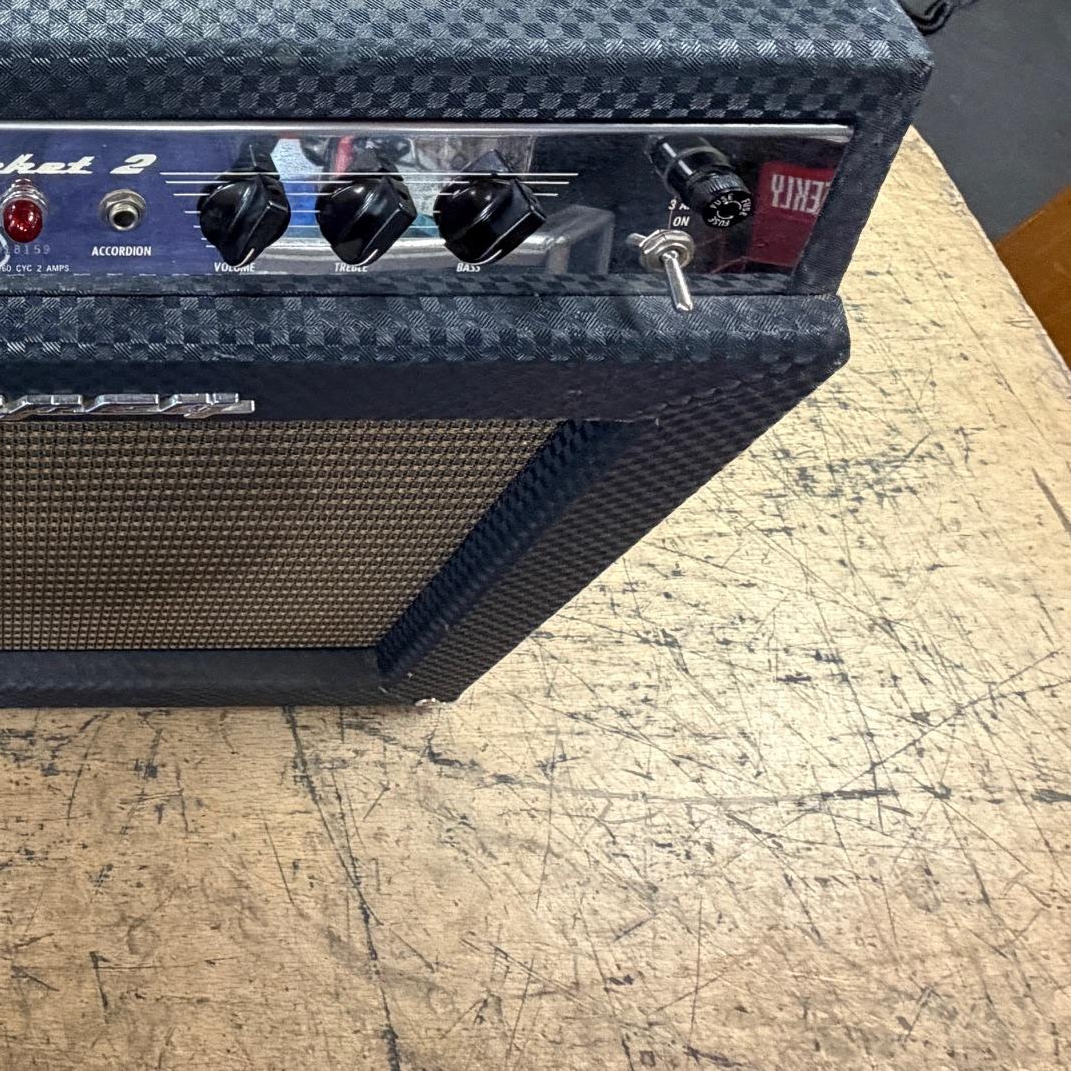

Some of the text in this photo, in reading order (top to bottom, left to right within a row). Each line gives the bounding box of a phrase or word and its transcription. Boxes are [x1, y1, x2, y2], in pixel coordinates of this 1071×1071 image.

[109, 153, 157, 175] 2
[672, 216, 690, 227] ON
[91, 245, 152, 257] ACCORDION
[15, 265, 33, 273] CYC
[36, 265, 42, 273] 2
[46, 264, 70, 273] AMPS
[334, 262, 369, 273] TREBLE
[456, 262, 481, 273] BASS
